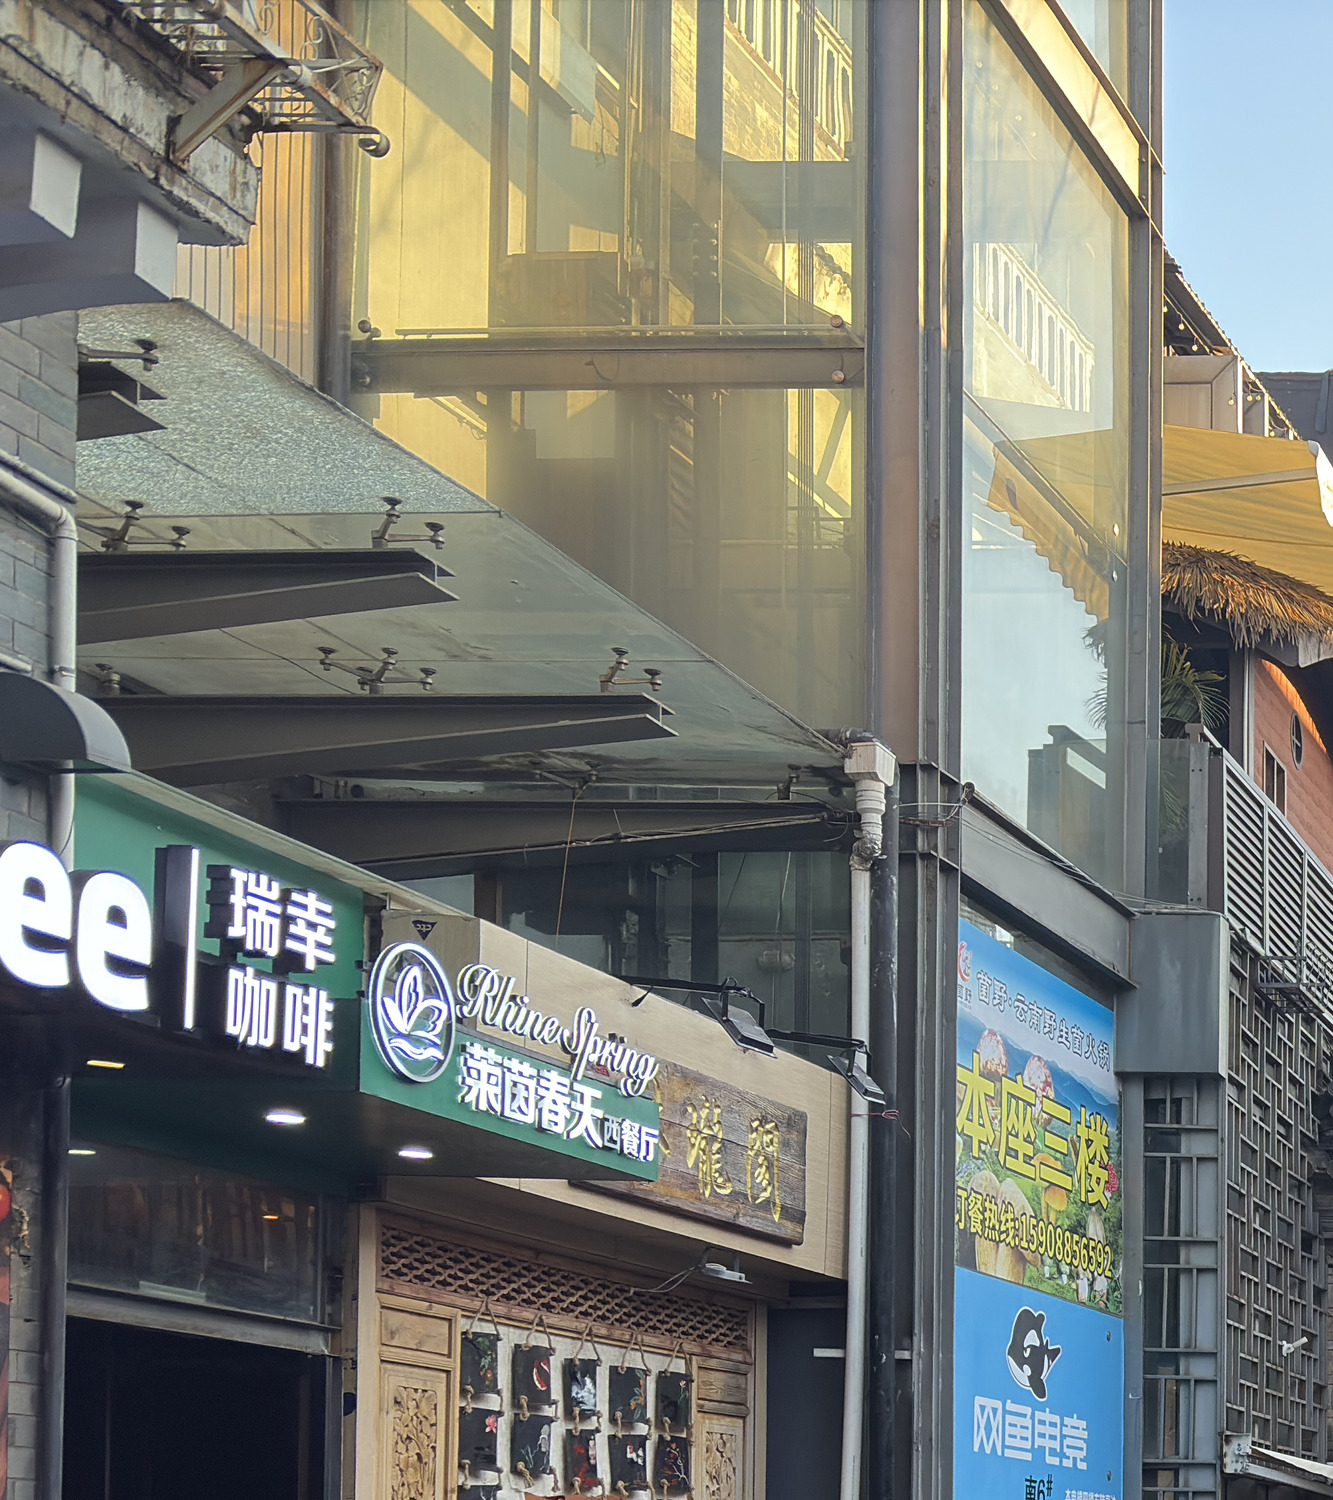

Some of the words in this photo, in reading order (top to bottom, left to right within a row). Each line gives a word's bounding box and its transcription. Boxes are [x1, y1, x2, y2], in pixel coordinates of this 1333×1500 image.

[226, 866, 337, 972] 瑞幸
[225, 966, 335, 1068] 咖啡
[456, 963, 562, 1044] Rhine
[559, 1006, 659, 1098] Spring
[457, 1042, 659, 1163] 莱茵春天西餐厅
[956, 1050, 1110, 1211] 本座三楼
[973, 1395, 1088, 1470] 网鱼电竞
